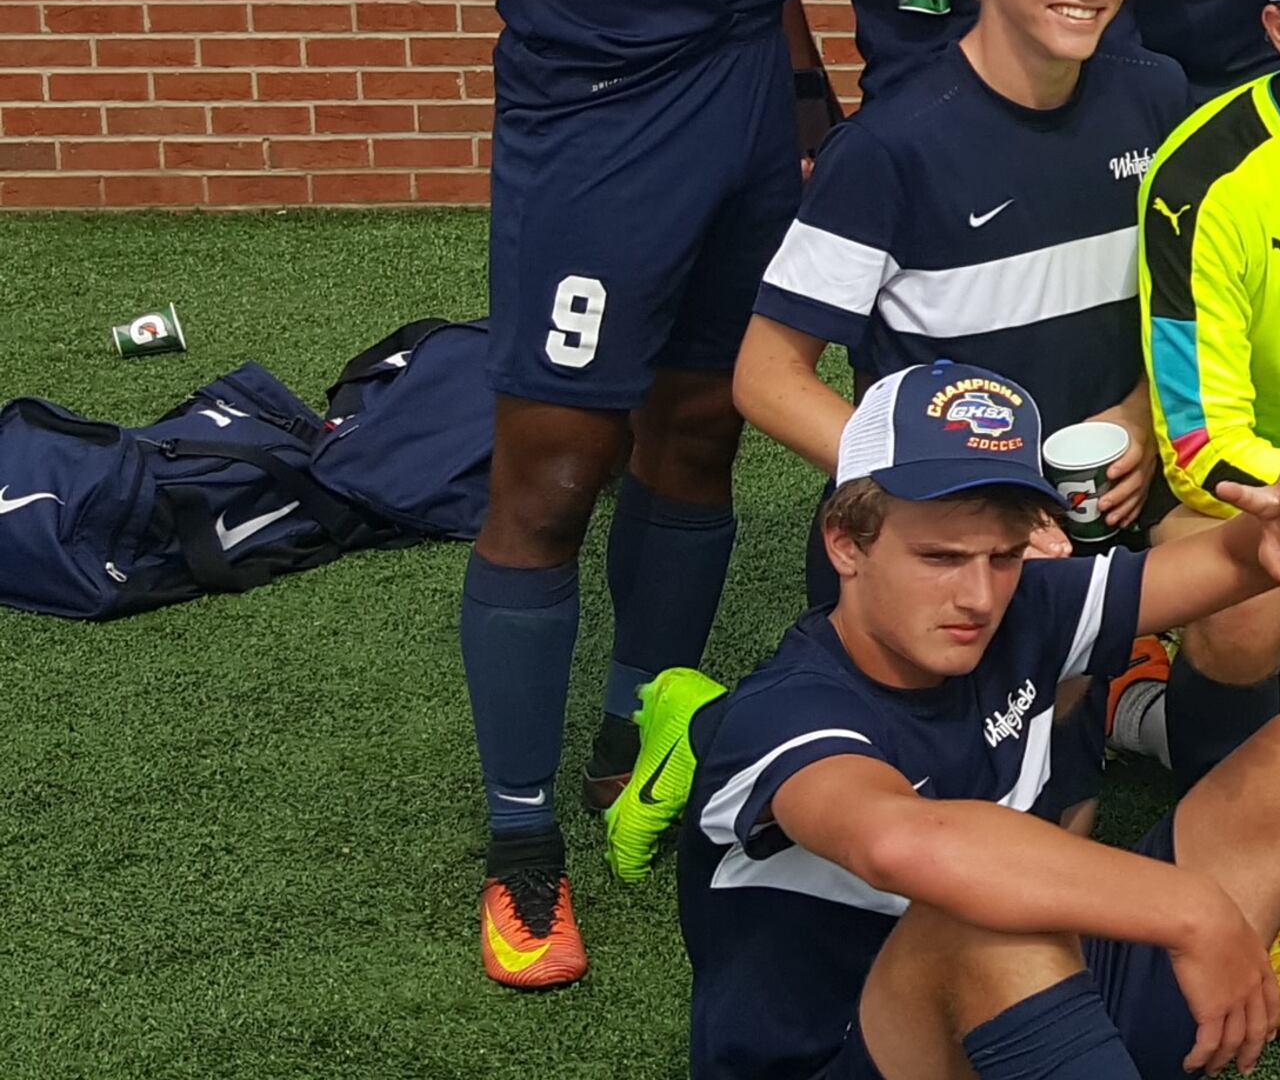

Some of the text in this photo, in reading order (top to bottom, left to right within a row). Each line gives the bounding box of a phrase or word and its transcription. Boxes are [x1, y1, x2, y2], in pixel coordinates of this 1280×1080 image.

[545, 275, 607, 368] 9
[927, 378, 1022, 418] CHAMPIONS
[951, 406, 1012, 420] GHSA
[967, 437, 1023, 451] SOCCER
[1057, 480, 1099, 523] G
[984, 679, 1037, 748] Whitefield
